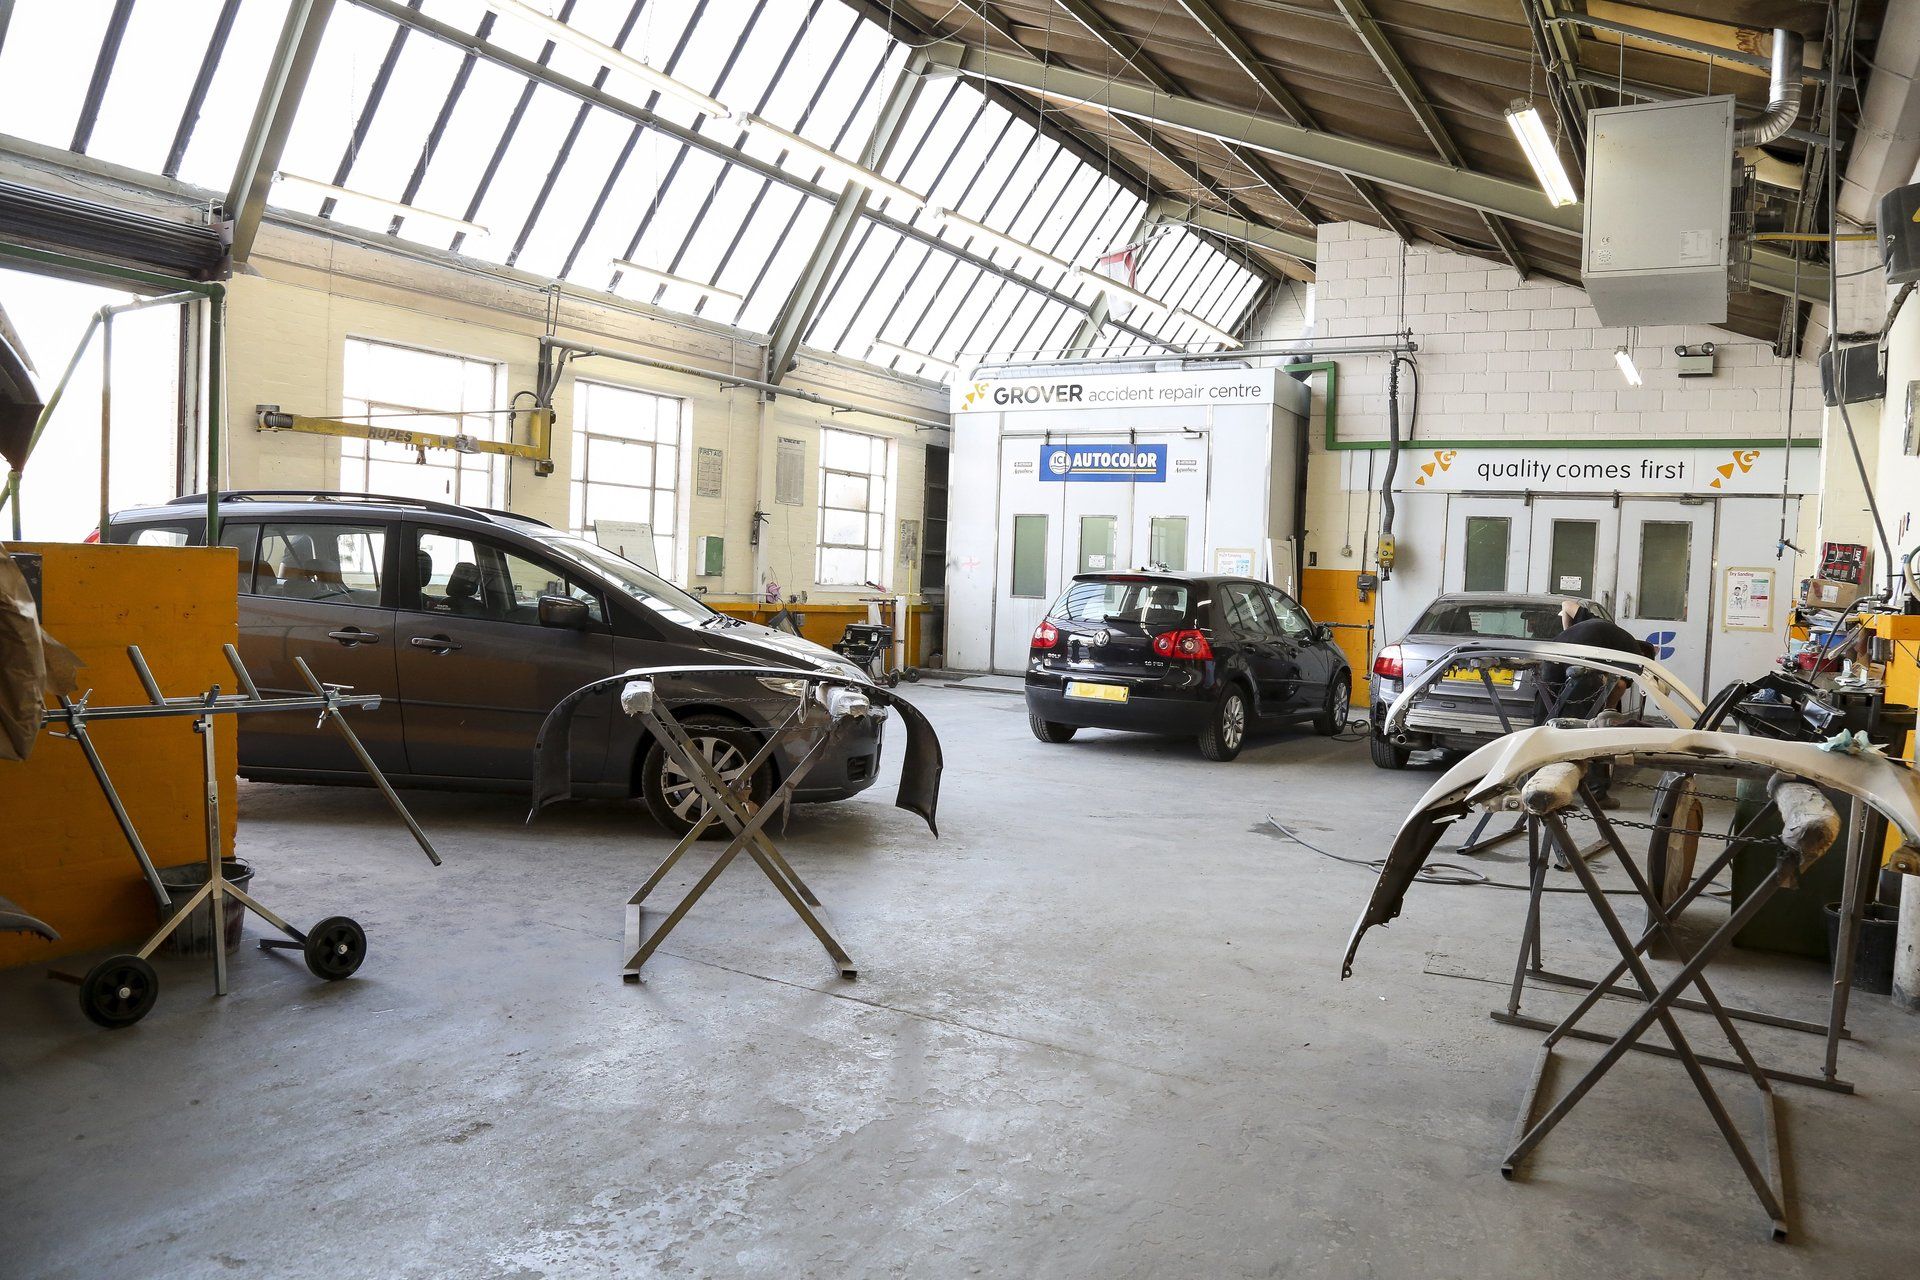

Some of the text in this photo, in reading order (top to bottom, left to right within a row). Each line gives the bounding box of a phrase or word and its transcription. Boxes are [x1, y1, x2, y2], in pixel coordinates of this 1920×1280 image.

[993, 383, 1261, 405] GROVER accident repair centre
[368, 426, 413, 442] RUPES
[1053, 452, 1157, 467] ICI AUTOCOLOR
[1477, 458, 1685, 482] quality comes first
